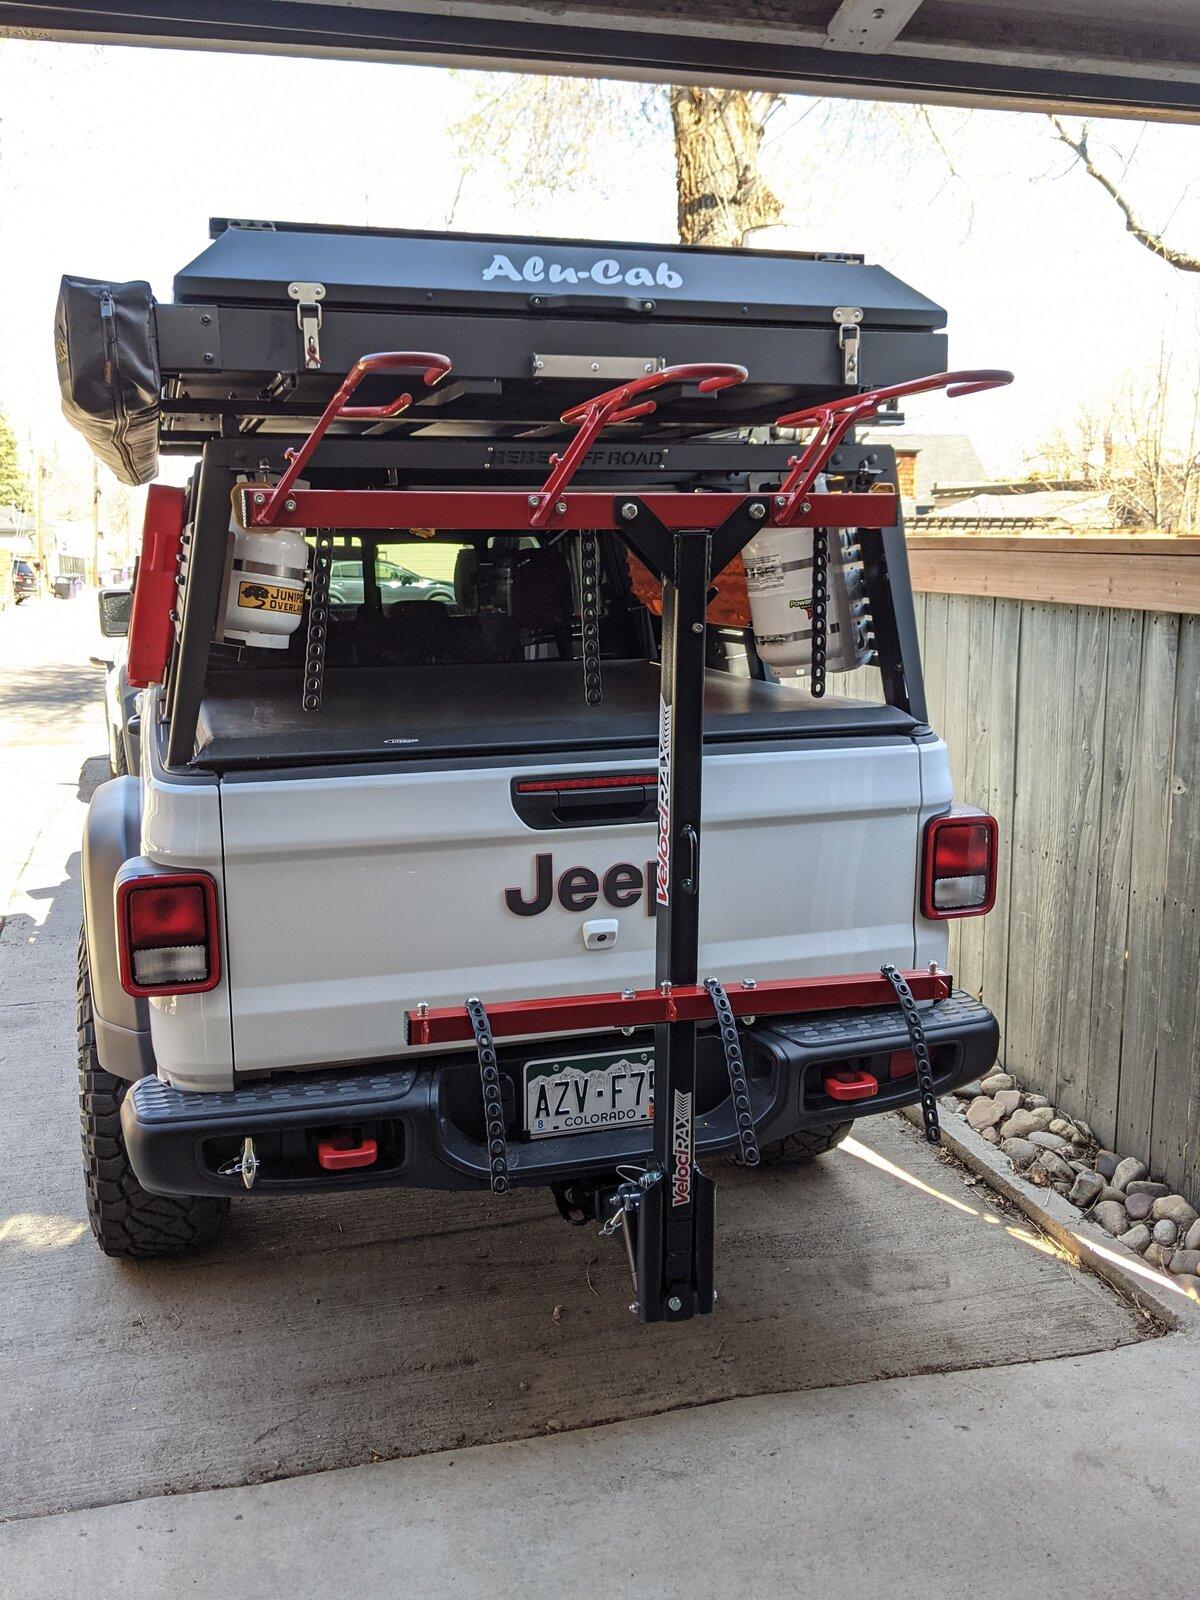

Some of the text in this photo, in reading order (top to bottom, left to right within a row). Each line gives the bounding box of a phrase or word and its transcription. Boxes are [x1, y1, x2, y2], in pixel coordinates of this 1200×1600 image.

[482, 254, 683, 289] Alu-Cab
[488, 450, 663, 466] REBE FF ROAD
[271, 589, 303, 603] JUNIPE
[656, 742, 672, 907] VelociRAX
[537, 1119, 544, 1129] 8
[565, 1109, 636, 1127] COLORADO
[672, 1115, 692, 1207] VelociRAX
